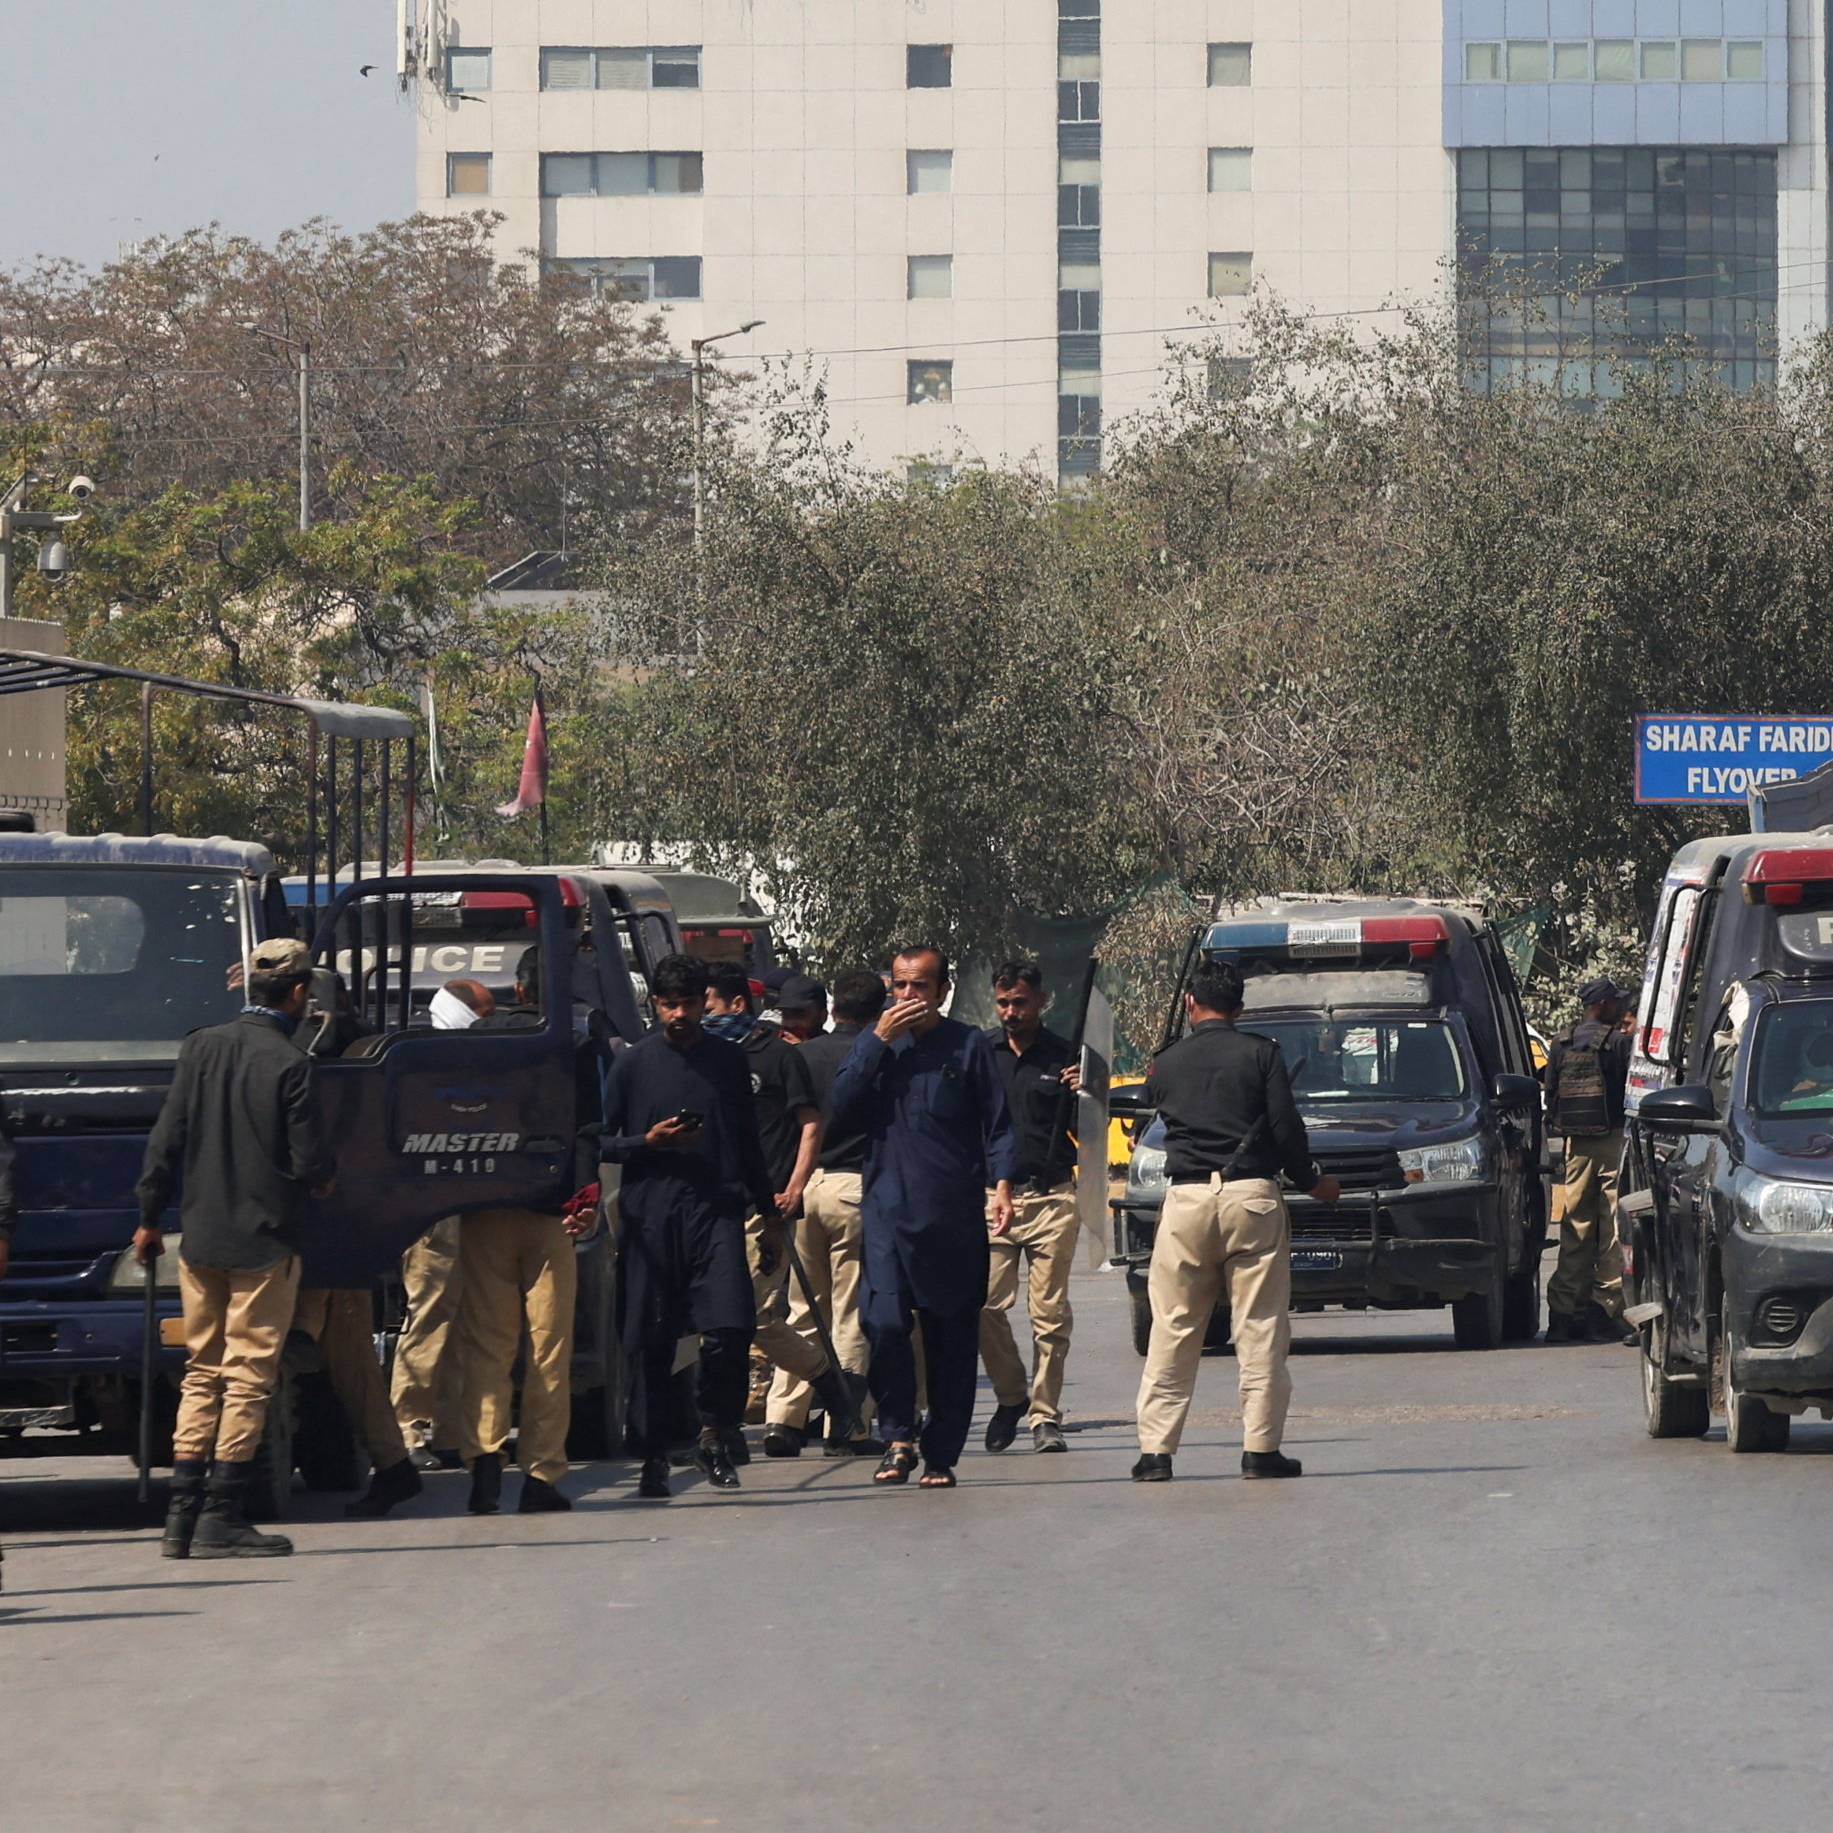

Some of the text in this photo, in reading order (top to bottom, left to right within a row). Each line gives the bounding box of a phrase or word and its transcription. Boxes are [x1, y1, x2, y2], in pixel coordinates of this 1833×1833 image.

[1646, 725, 1751, 753] SHARAF
[318, 945, 505, 974] OLICE
[402, 1132, 520, 1154] MASTER
[424, 1158, 496, 1175] M-410
